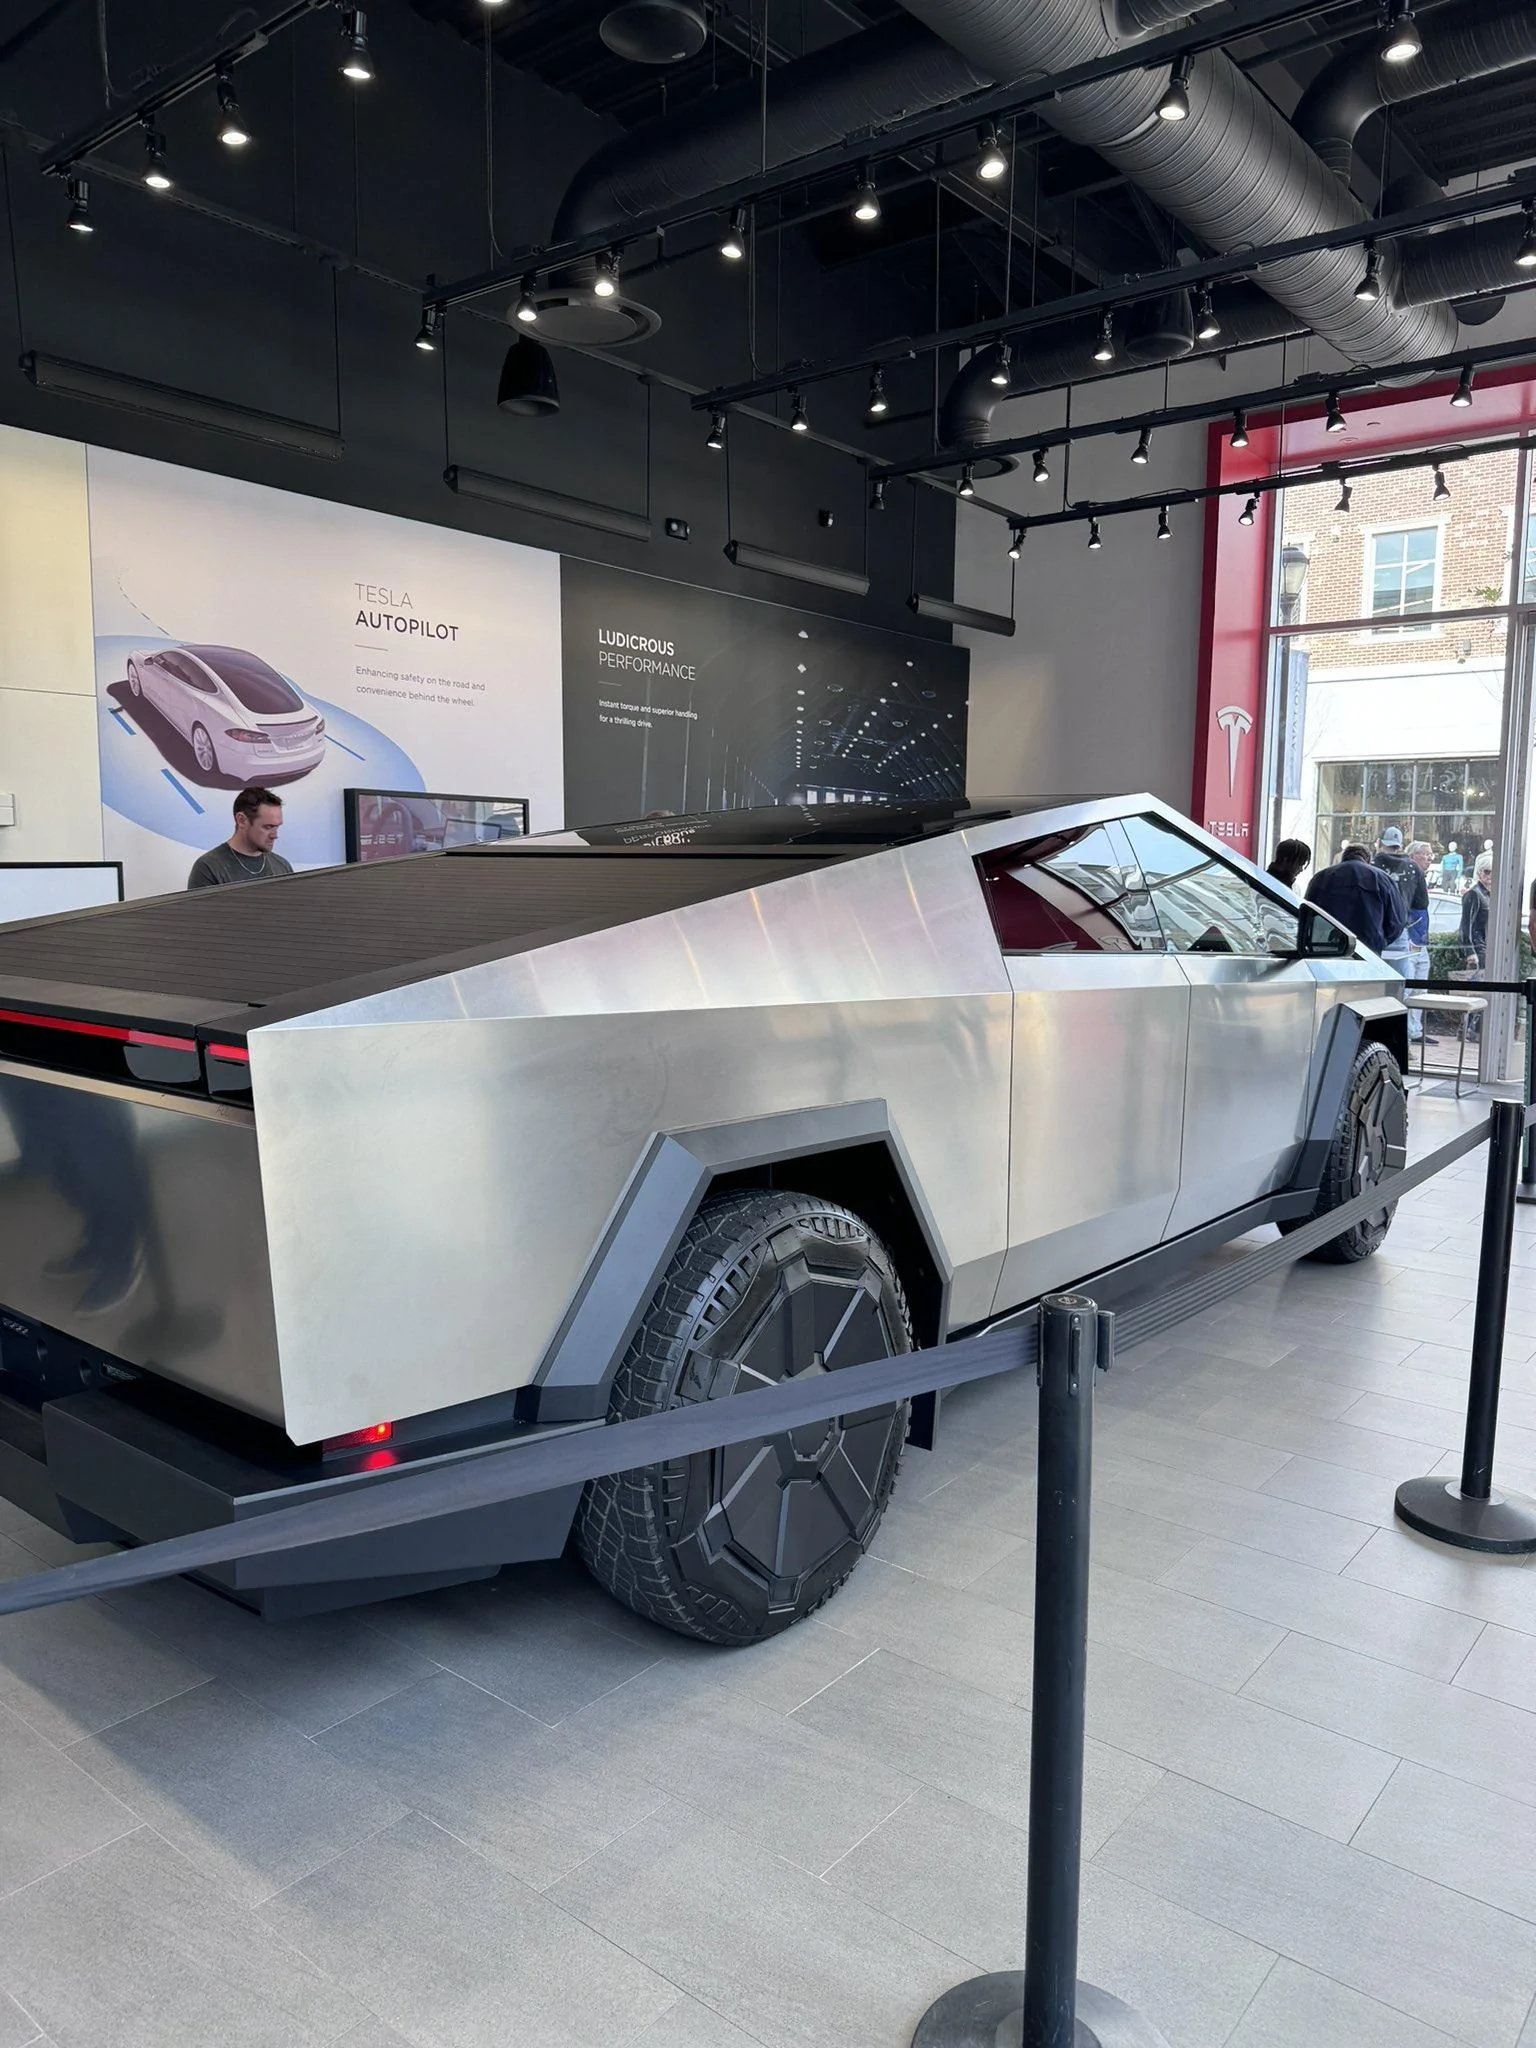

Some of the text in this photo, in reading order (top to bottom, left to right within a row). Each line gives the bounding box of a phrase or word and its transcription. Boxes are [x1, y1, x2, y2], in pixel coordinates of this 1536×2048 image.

[355, 583, 413, 609] TESLA
[355, 610, 459, 641] AUTOPILOT
[599, 628, 675, 656] LUDICROUS
[356, 666, 485, 691] Enhancing safety on the road and
[599, 651, 696, 681] PERFORMANCE
[356, 686, 407, 699] convenience
[409, 691, 435, 702] behind
[437, 695, 450, 704] the
[599, 699, 698, 720] Instant torque and superior handling
[599, 714, 608, 723] for
[614, 716, 636, 728] thrilling
[1209, 821, 1249, 838] TESLA
